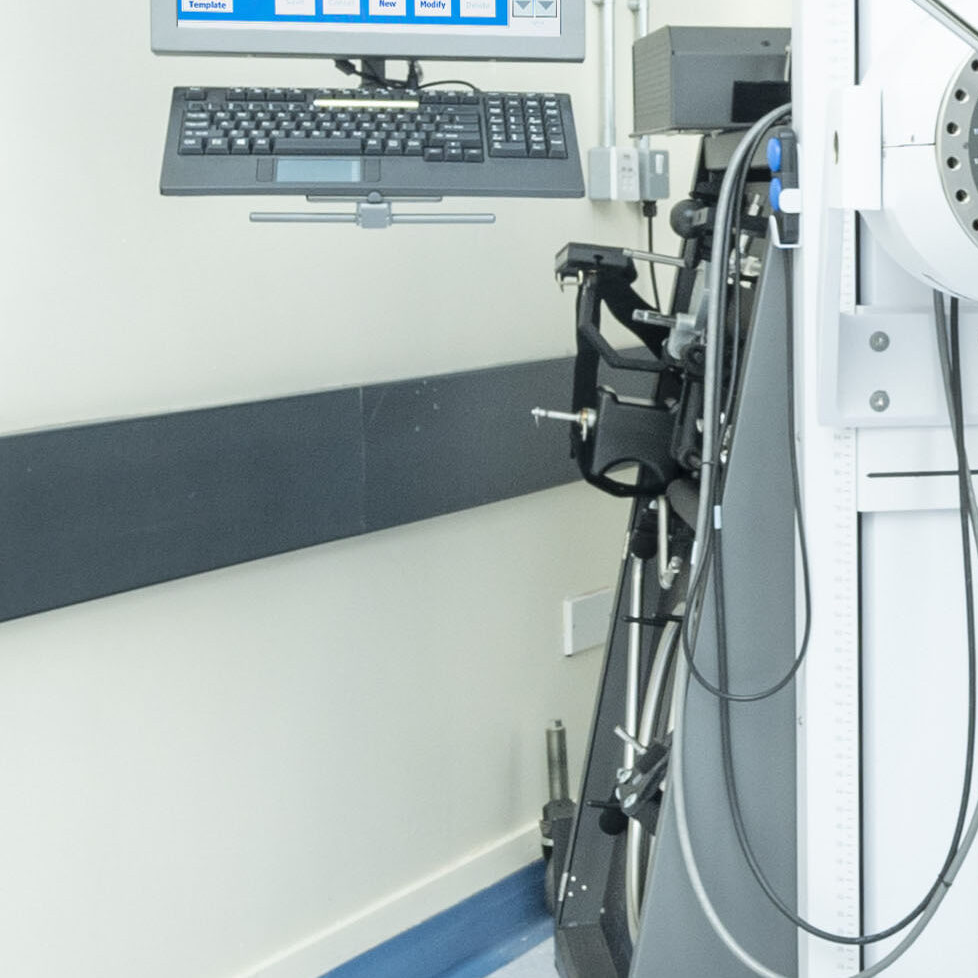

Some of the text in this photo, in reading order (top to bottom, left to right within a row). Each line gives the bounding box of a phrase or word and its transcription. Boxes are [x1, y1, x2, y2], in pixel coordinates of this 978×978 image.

[189, 1, 227, 10] Template
[378, 0, 397, 8] New
[420, 0, 446, 10] Modify
